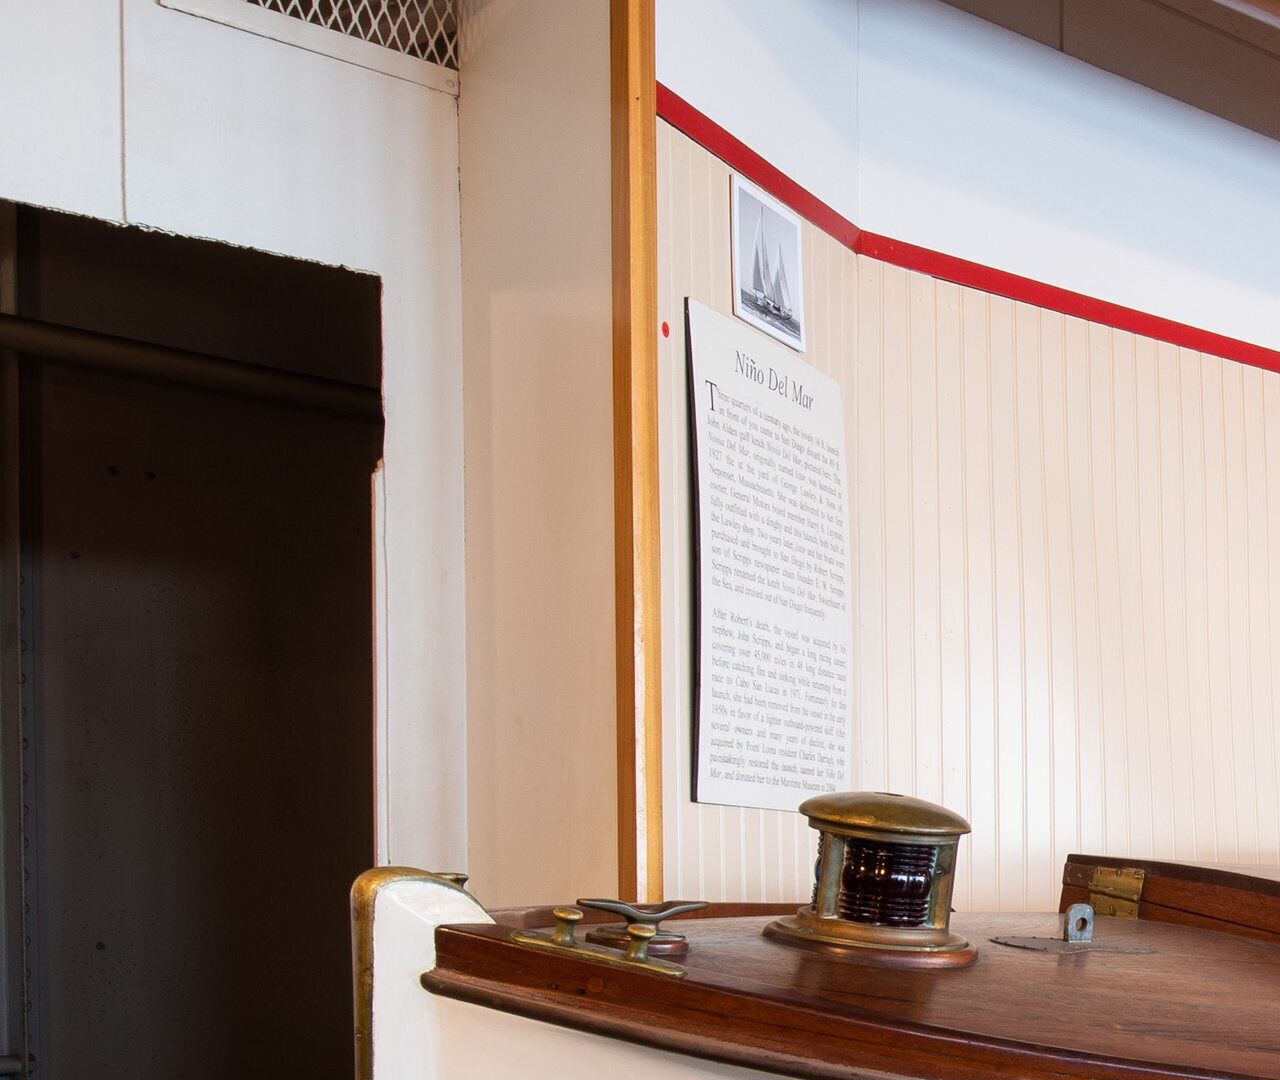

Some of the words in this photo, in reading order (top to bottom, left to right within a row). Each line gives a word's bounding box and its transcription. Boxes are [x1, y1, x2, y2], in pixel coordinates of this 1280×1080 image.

[735, 351, 764, 384] Niño
[768, 368, 788, 398] Del
[792, 381, 813, 410] Mar
